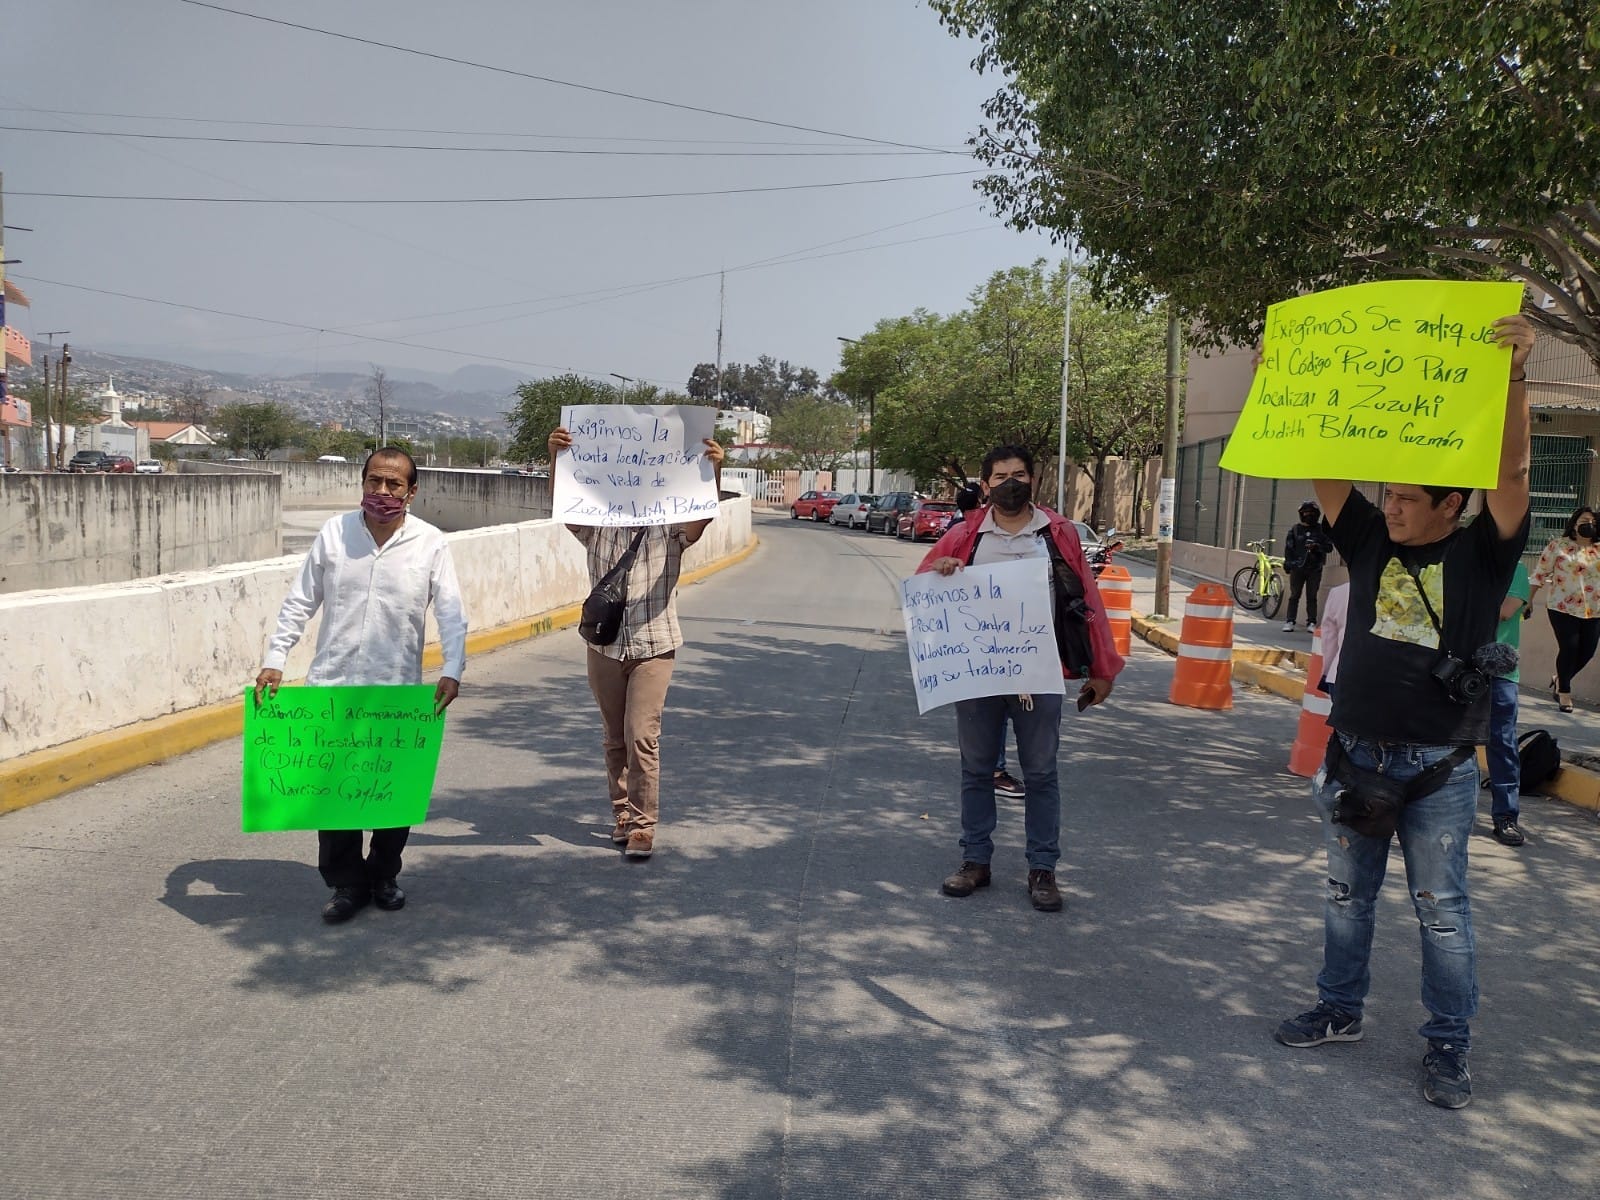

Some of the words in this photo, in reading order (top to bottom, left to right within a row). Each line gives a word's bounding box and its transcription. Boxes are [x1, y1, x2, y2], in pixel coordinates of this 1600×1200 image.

[1270, 306, 1357, 345] Exigimos
[1266, 354, 1280, 372] el
[1288, 347, 1332, 377] Código
[1335, 344, 1404, 378] Rojo
[1414, 354, 1469, 384] Para
[1258, 377, 1317, 408] localizar
[1327, 388, 1339, 407] a
[1348, 385, 1445, 418] Zuzuki
[568, 409, 642, 441] Exigimos
[653, 418, 669, 443] la
[1252, 415, 1305, 441] Judith
[1307, 413, 1389, 439] Blanco
[1399, 422, 1465, 451] Guzmán
[616, 444, 700, 465] localización
[651, 472, 666, 487] de
[903, 580, 969, 608] Exigimos
[974, 585, 982, 599] a
[990, 574, 1002, 599] la
[958, 605, 1010, 633] Sandra
[1018, 601, 1048, 635] Luz
[973, 636, 1038, 654] Salmerón
[918, 671, 938, 694] haga
[321, 697, 334, 721] el
[254, 728, 276, 746] de
[288, 727, 302, 747] la
[304, 726, 383, 748] Presidenta
[390, 727, 407, 749] de
[414, 728, 426, 749] la
[269, 770, 331, 797] Narciso
